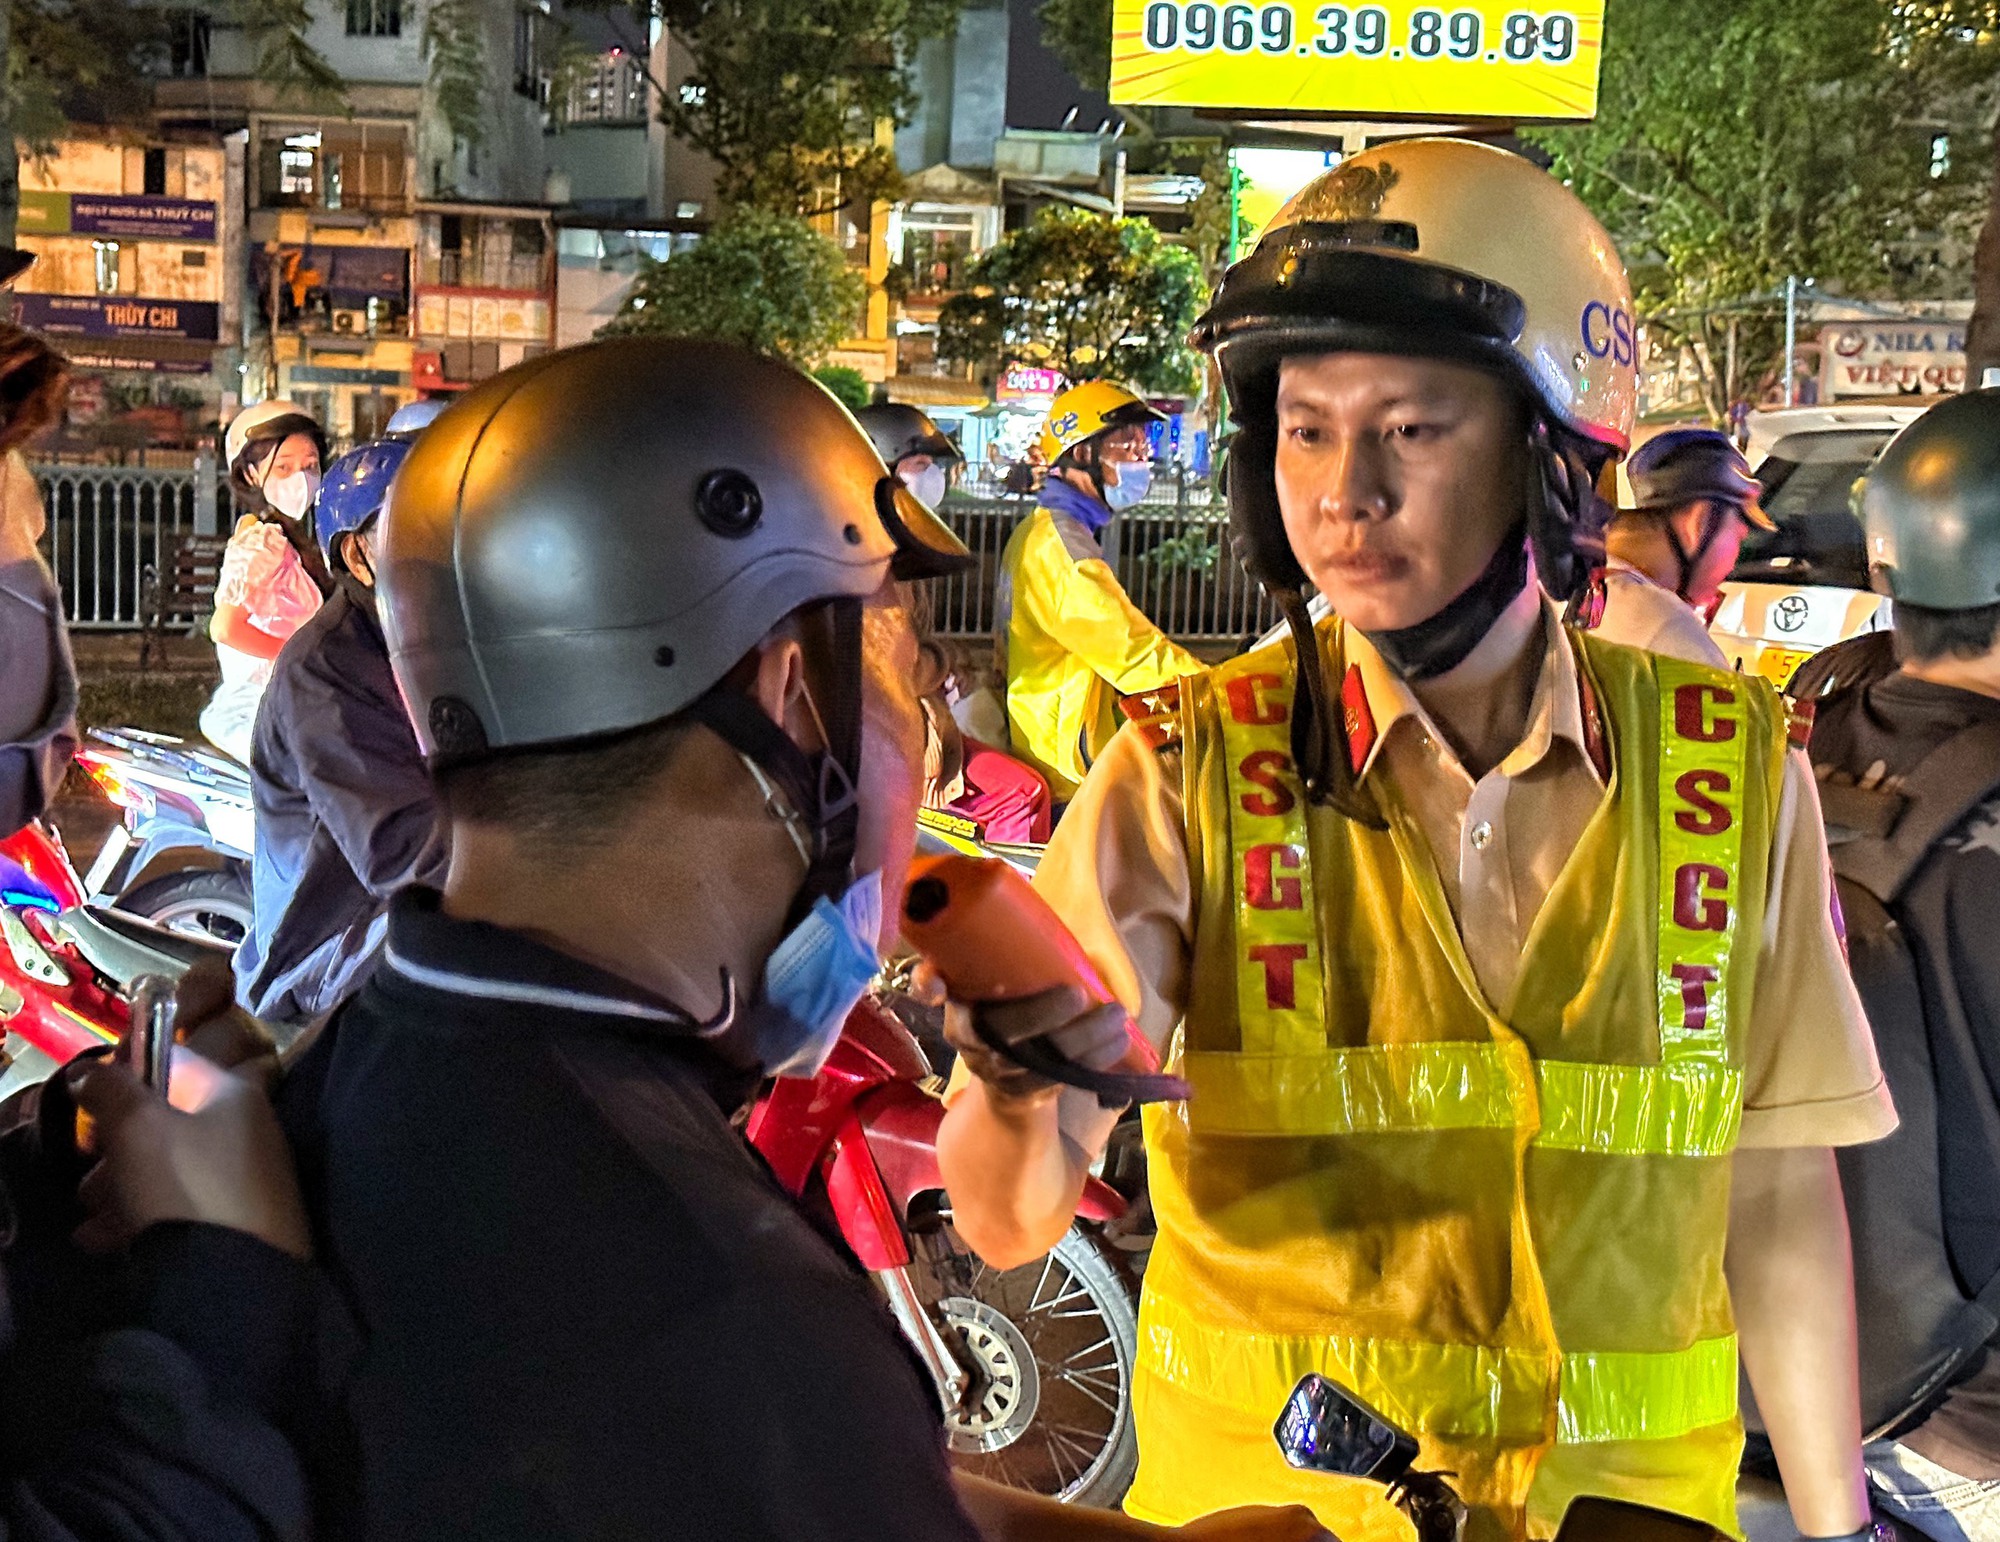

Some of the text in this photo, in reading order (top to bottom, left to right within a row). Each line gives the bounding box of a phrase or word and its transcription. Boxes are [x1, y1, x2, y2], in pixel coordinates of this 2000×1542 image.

[1147, 2, 1574, 61] 0969.39.89.89
[149, 307, 178, 328] CHI
[1582, 301, 1637, 368] CS
[1226, 673, 1308, 1009] CSGT
[1671, 684, 1737, 1029] CSGT
